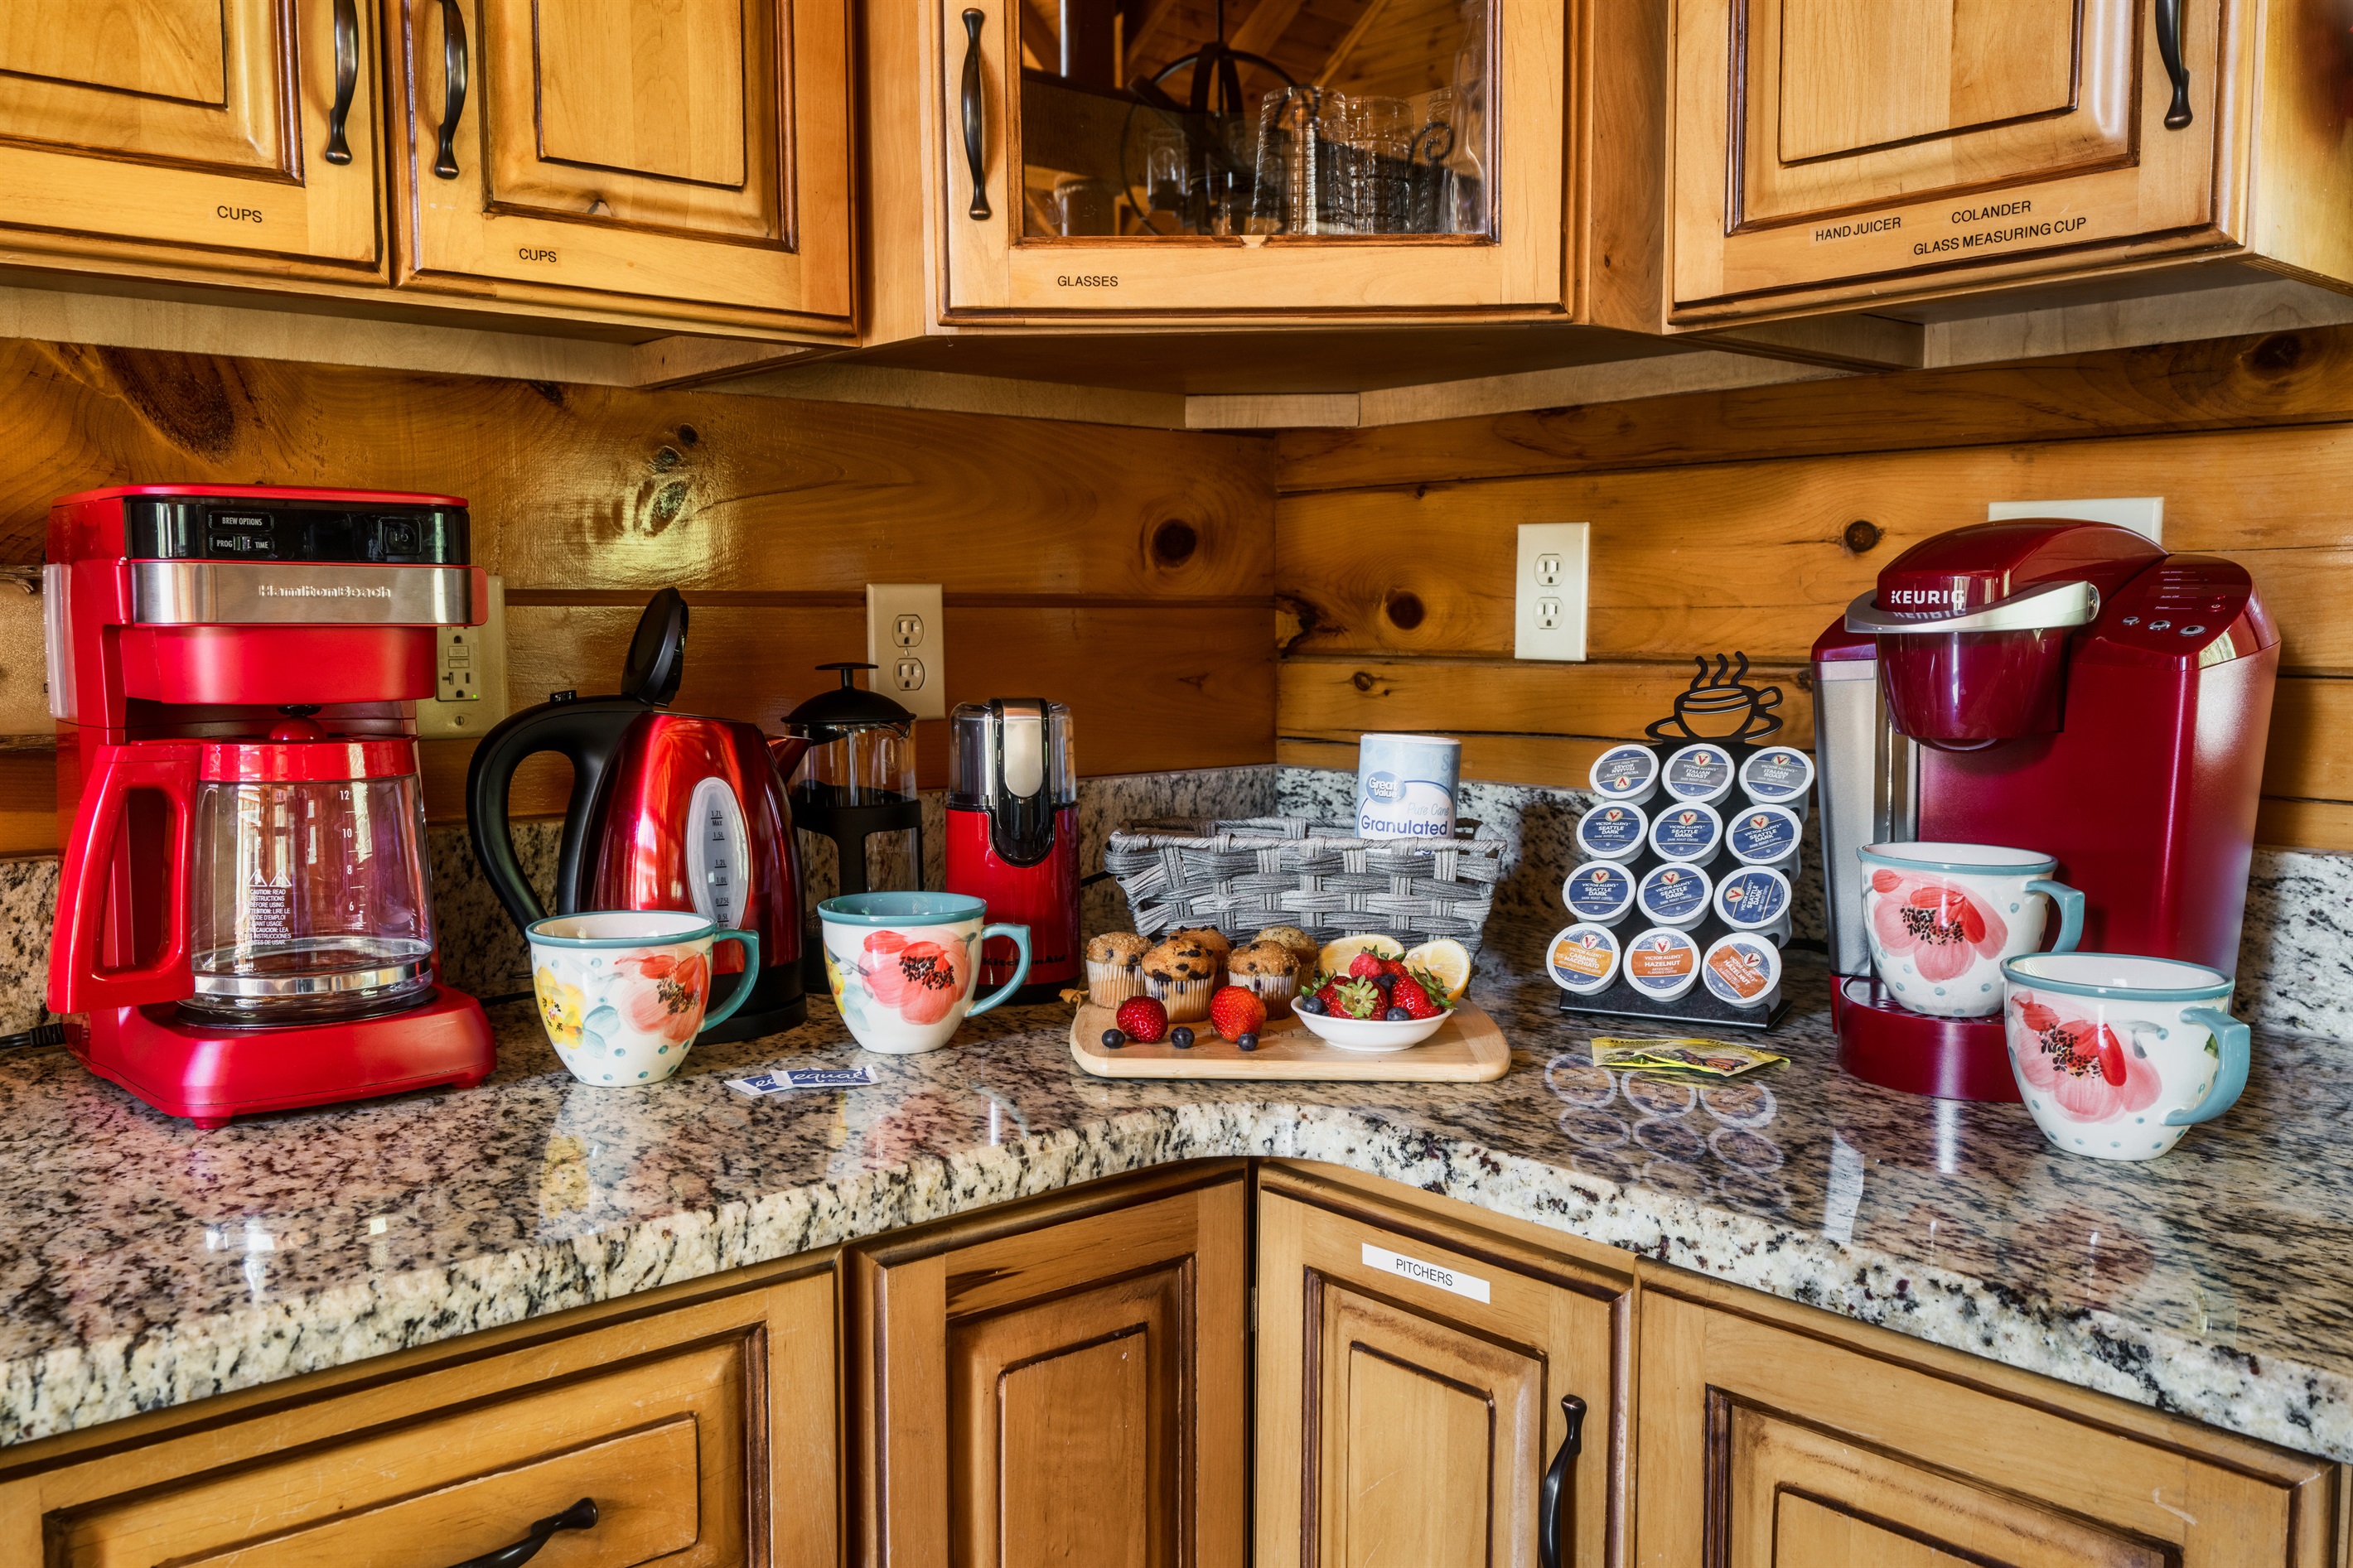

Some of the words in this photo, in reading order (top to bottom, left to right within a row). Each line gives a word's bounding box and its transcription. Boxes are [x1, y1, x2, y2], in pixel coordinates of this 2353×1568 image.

[216, 205, 263, 224] CUPS
[1951, 200, 2032, 224] COLANDER
[1815, 225, 1851, 241] HAND
[1853, 216, 1901, 235] JUICER
[1913, 238, 1959, 255] GLASS
[1962, 223, 2051, 248] MEASURING
[2054, 217, 2087, 234] CUP
[518, 247, 557, 263] CUPS
[1057, 275, 1119, 287] GLASSES
[222, 517, 238, 525] BREW
[239, 517, 263, 526] OPTIONS
[216, 539, 233, 548] PROG
[254, 541, 268, 549] TIME
[1891, 590, 1964, 605] KEURIG
[1369, 777, 1399, 791] Great
[340, 790, 350, 800] 12
[1374, 789, 1399, 798] Value
[1431, 803, 1450, 817] Cane
[1361, 815, 1447, 836] Granulated
[342, 828, 352, 838] 10
[1749, 829, 1777, 840] SEATTLE
[1755, 834, 1774, 842] DARK
[347, 865, 352, 875] 8
[1660, 886, 1688, 896] SEATTLE
[1665, 891, 1684, 900] DARK
[349, 901, 355, 911] 6
[982, 954, 1065, 967] KitcnAid
[1564, 956, 1600, 969] MACCHIATO
[1569, 953, 1597, 964] CARAMEL
[1723, 959, 1751, 986] HAZELNUT
[1396, 1258, 1453, 1286] PITCHERS
